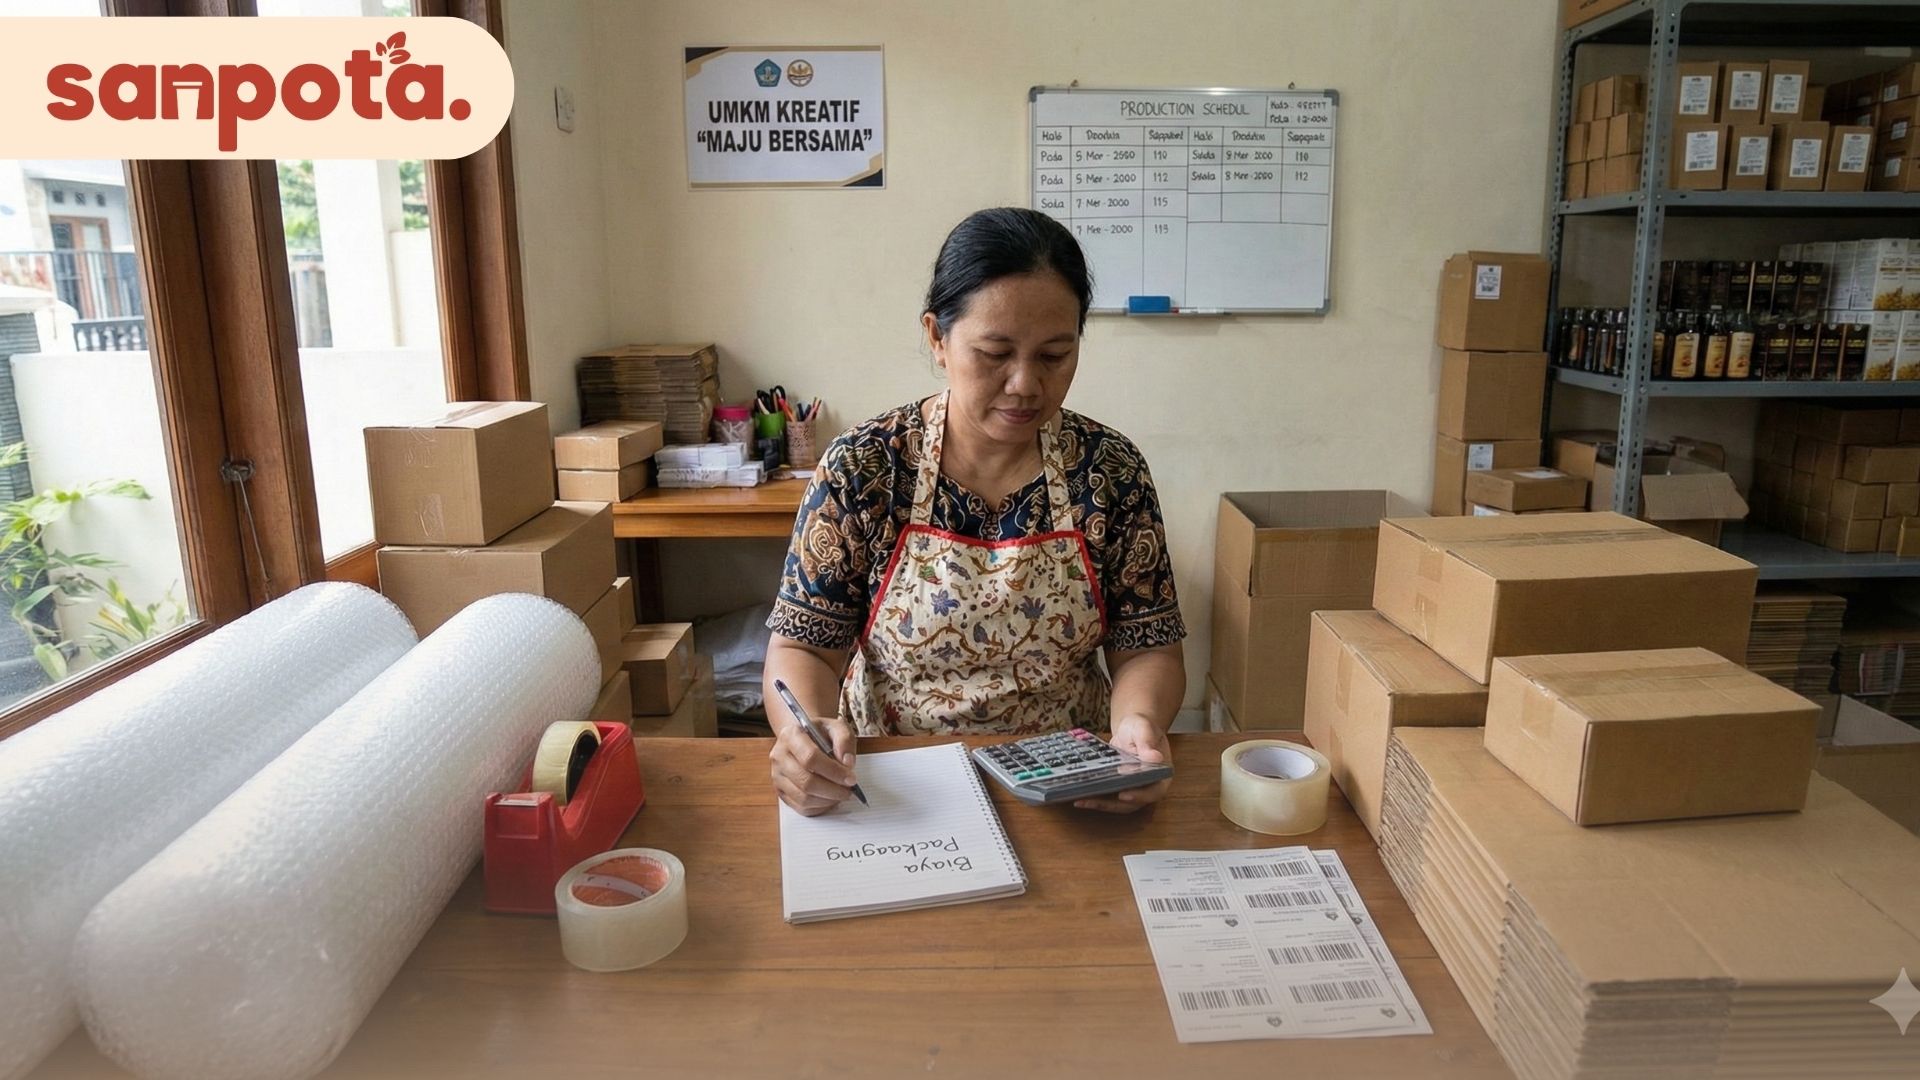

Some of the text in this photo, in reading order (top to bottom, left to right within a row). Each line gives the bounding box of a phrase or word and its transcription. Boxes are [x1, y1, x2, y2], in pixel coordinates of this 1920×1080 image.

[708, 100, 860, 123] UMKM KREATIF
[1120, 100, 1251, 117] PRODUCTION SCHEDUL
[697, 128, 872, 153] “MAJU BERSAMA”
[904, 855, 972, 874] Biaya
